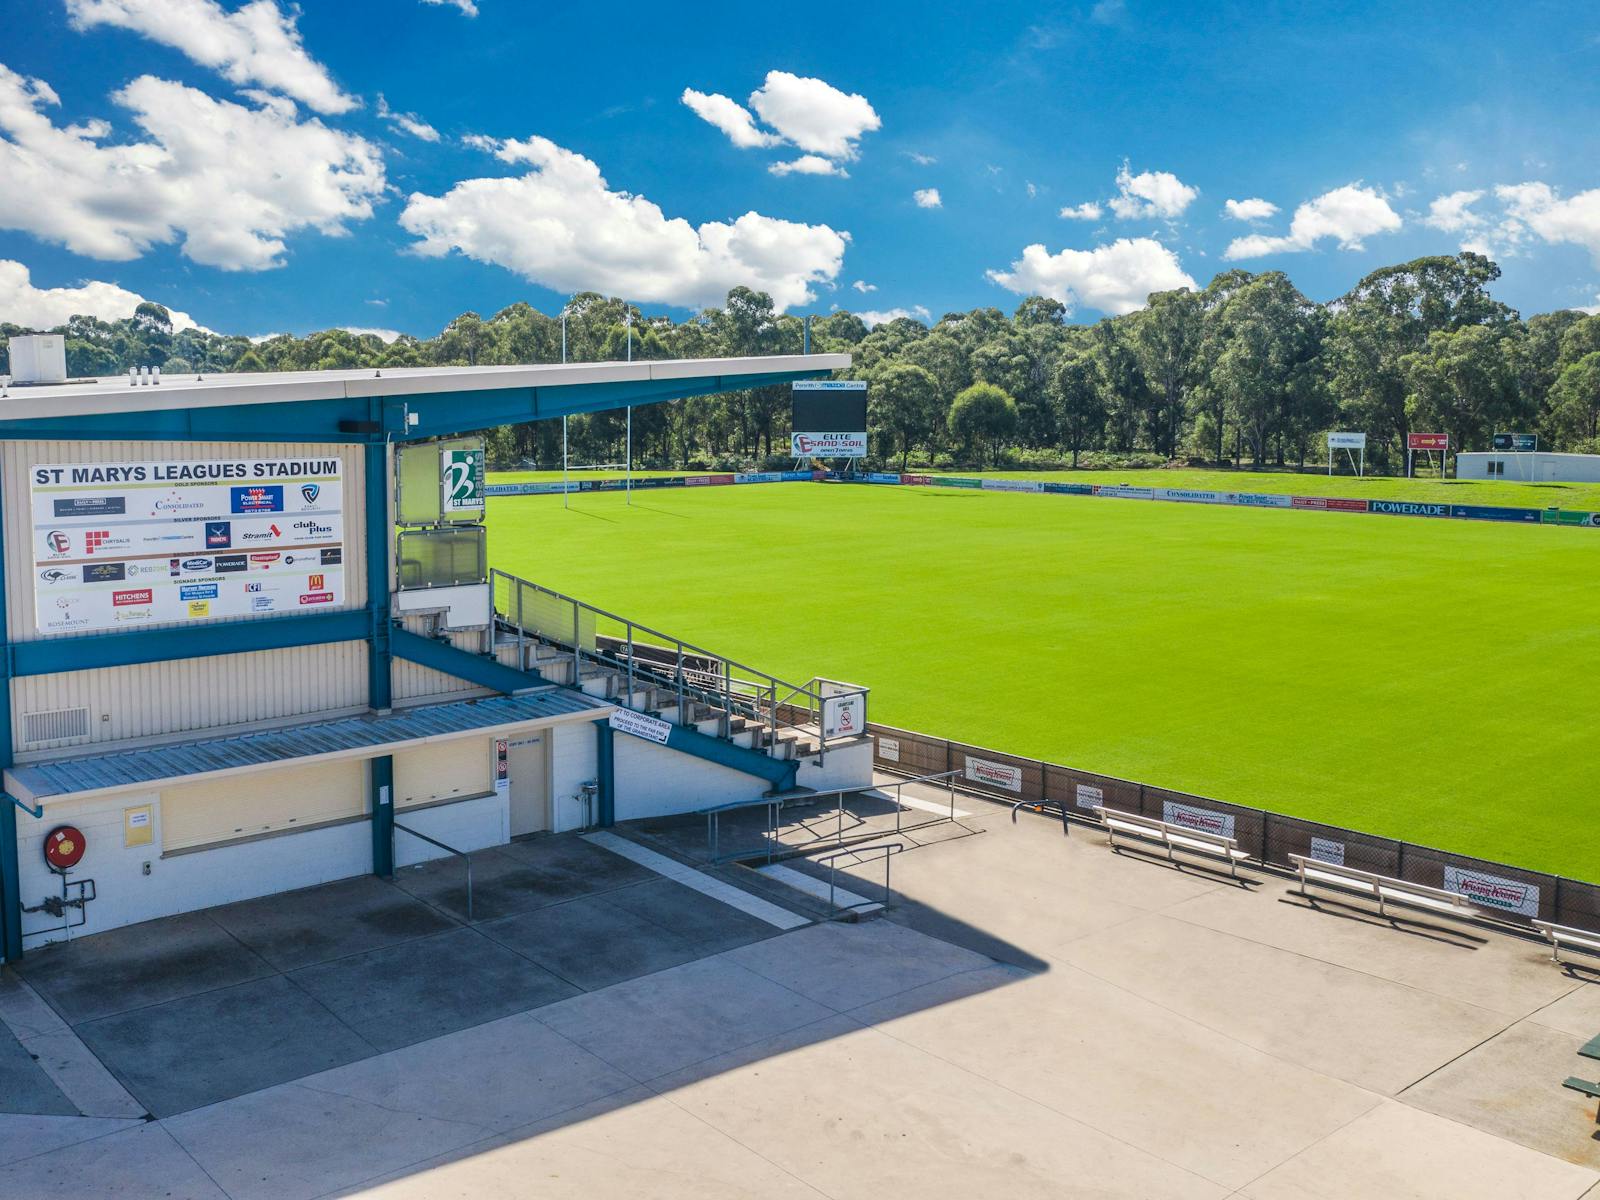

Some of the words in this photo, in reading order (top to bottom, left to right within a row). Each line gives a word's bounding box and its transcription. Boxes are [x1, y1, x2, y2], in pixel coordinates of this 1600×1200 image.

[36, 468, 64, 484] ST
[72, 466, 147, 483] MARYS
[153, 462, 247, 480] LEAGUES
[253, 460, 337, 477] STADIUM
[1167, 490, 1215, 499] CONSOLIDATED
[155, 501, 204, 511] CONSOLIDATED
[1372, 502, 1446, 515] POWERADE
[293, 521, 316, 529] club
[309, 526, 332, 535] plus
[242, 532, 273, 540] Stramit
[115, 592, 149, 601] HITCHENS
[48, 619, 89, 627] ROSEMOUNT
[614, 716, 634, 726] PROCEED
[630, 713, 658, 726] CORPORATE
[659, 722, 671, 730] AREA
[1461, 879, 1491, 896] Krispy
[1491, 886, 1523, 902] Kreme
